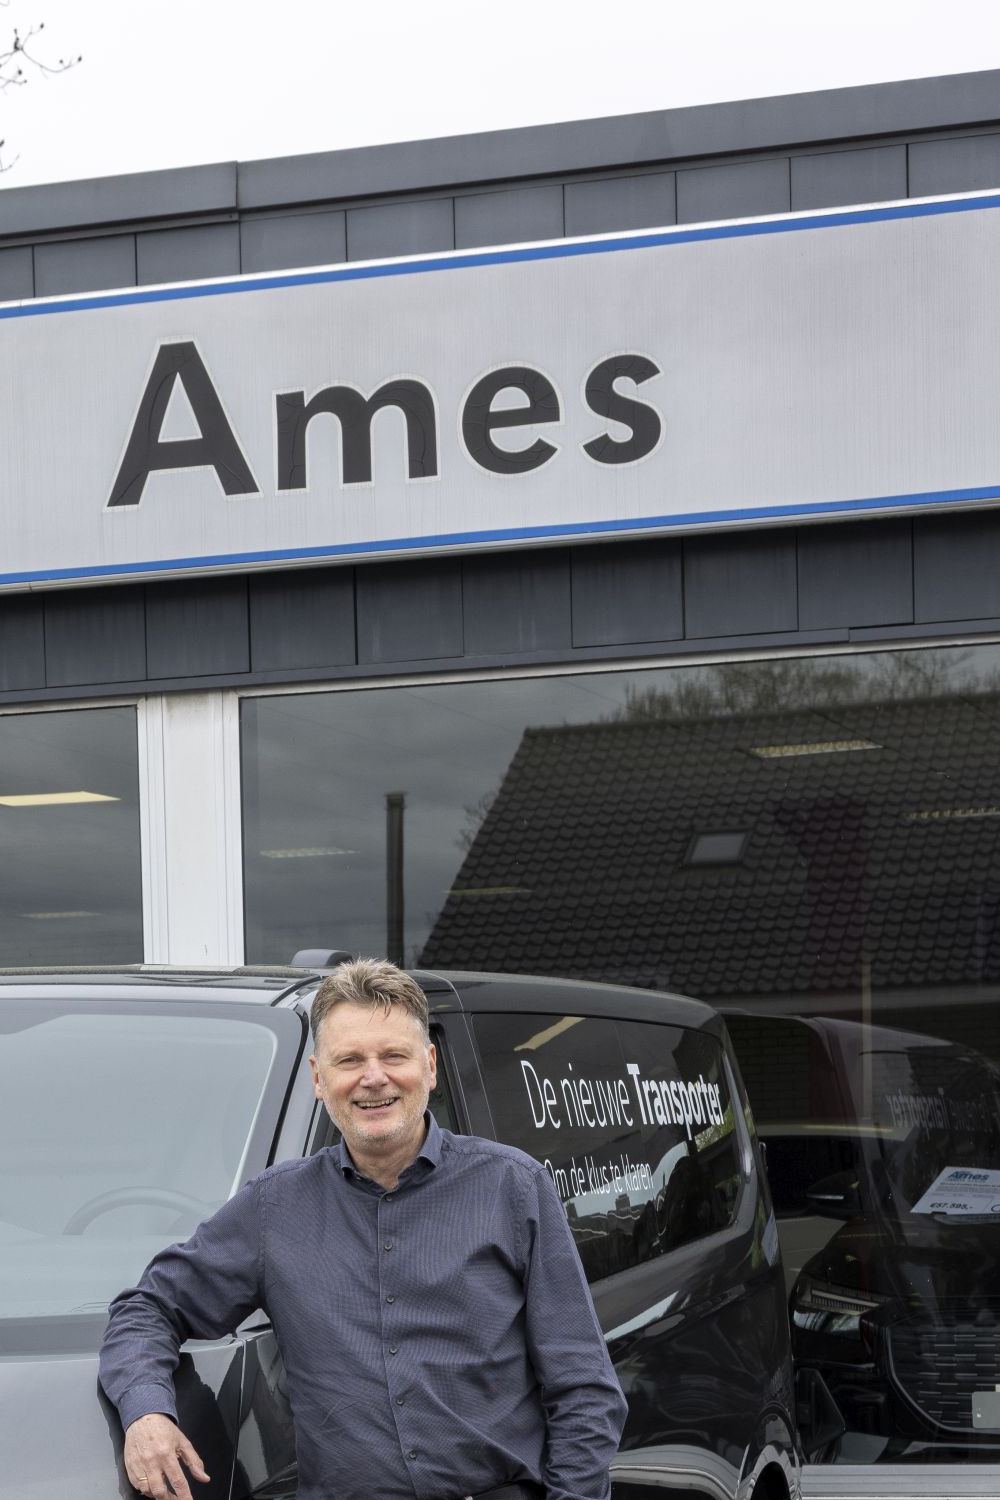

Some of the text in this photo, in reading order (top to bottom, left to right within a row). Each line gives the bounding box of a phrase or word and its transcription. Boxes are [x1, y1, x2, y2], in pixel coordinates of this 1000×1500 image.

[106, 338, 664, 509] Ames
[520, 1060, 724, 1141] De nieuwe Transporter
[570, 1157, 586, 1196] de
[585, 1155, 610, 1194] klus
[609, 1160, 622, 1193] te
[621, 1154, 654, 1190] klaren
[947, 1170, 990, 1181] Ames
